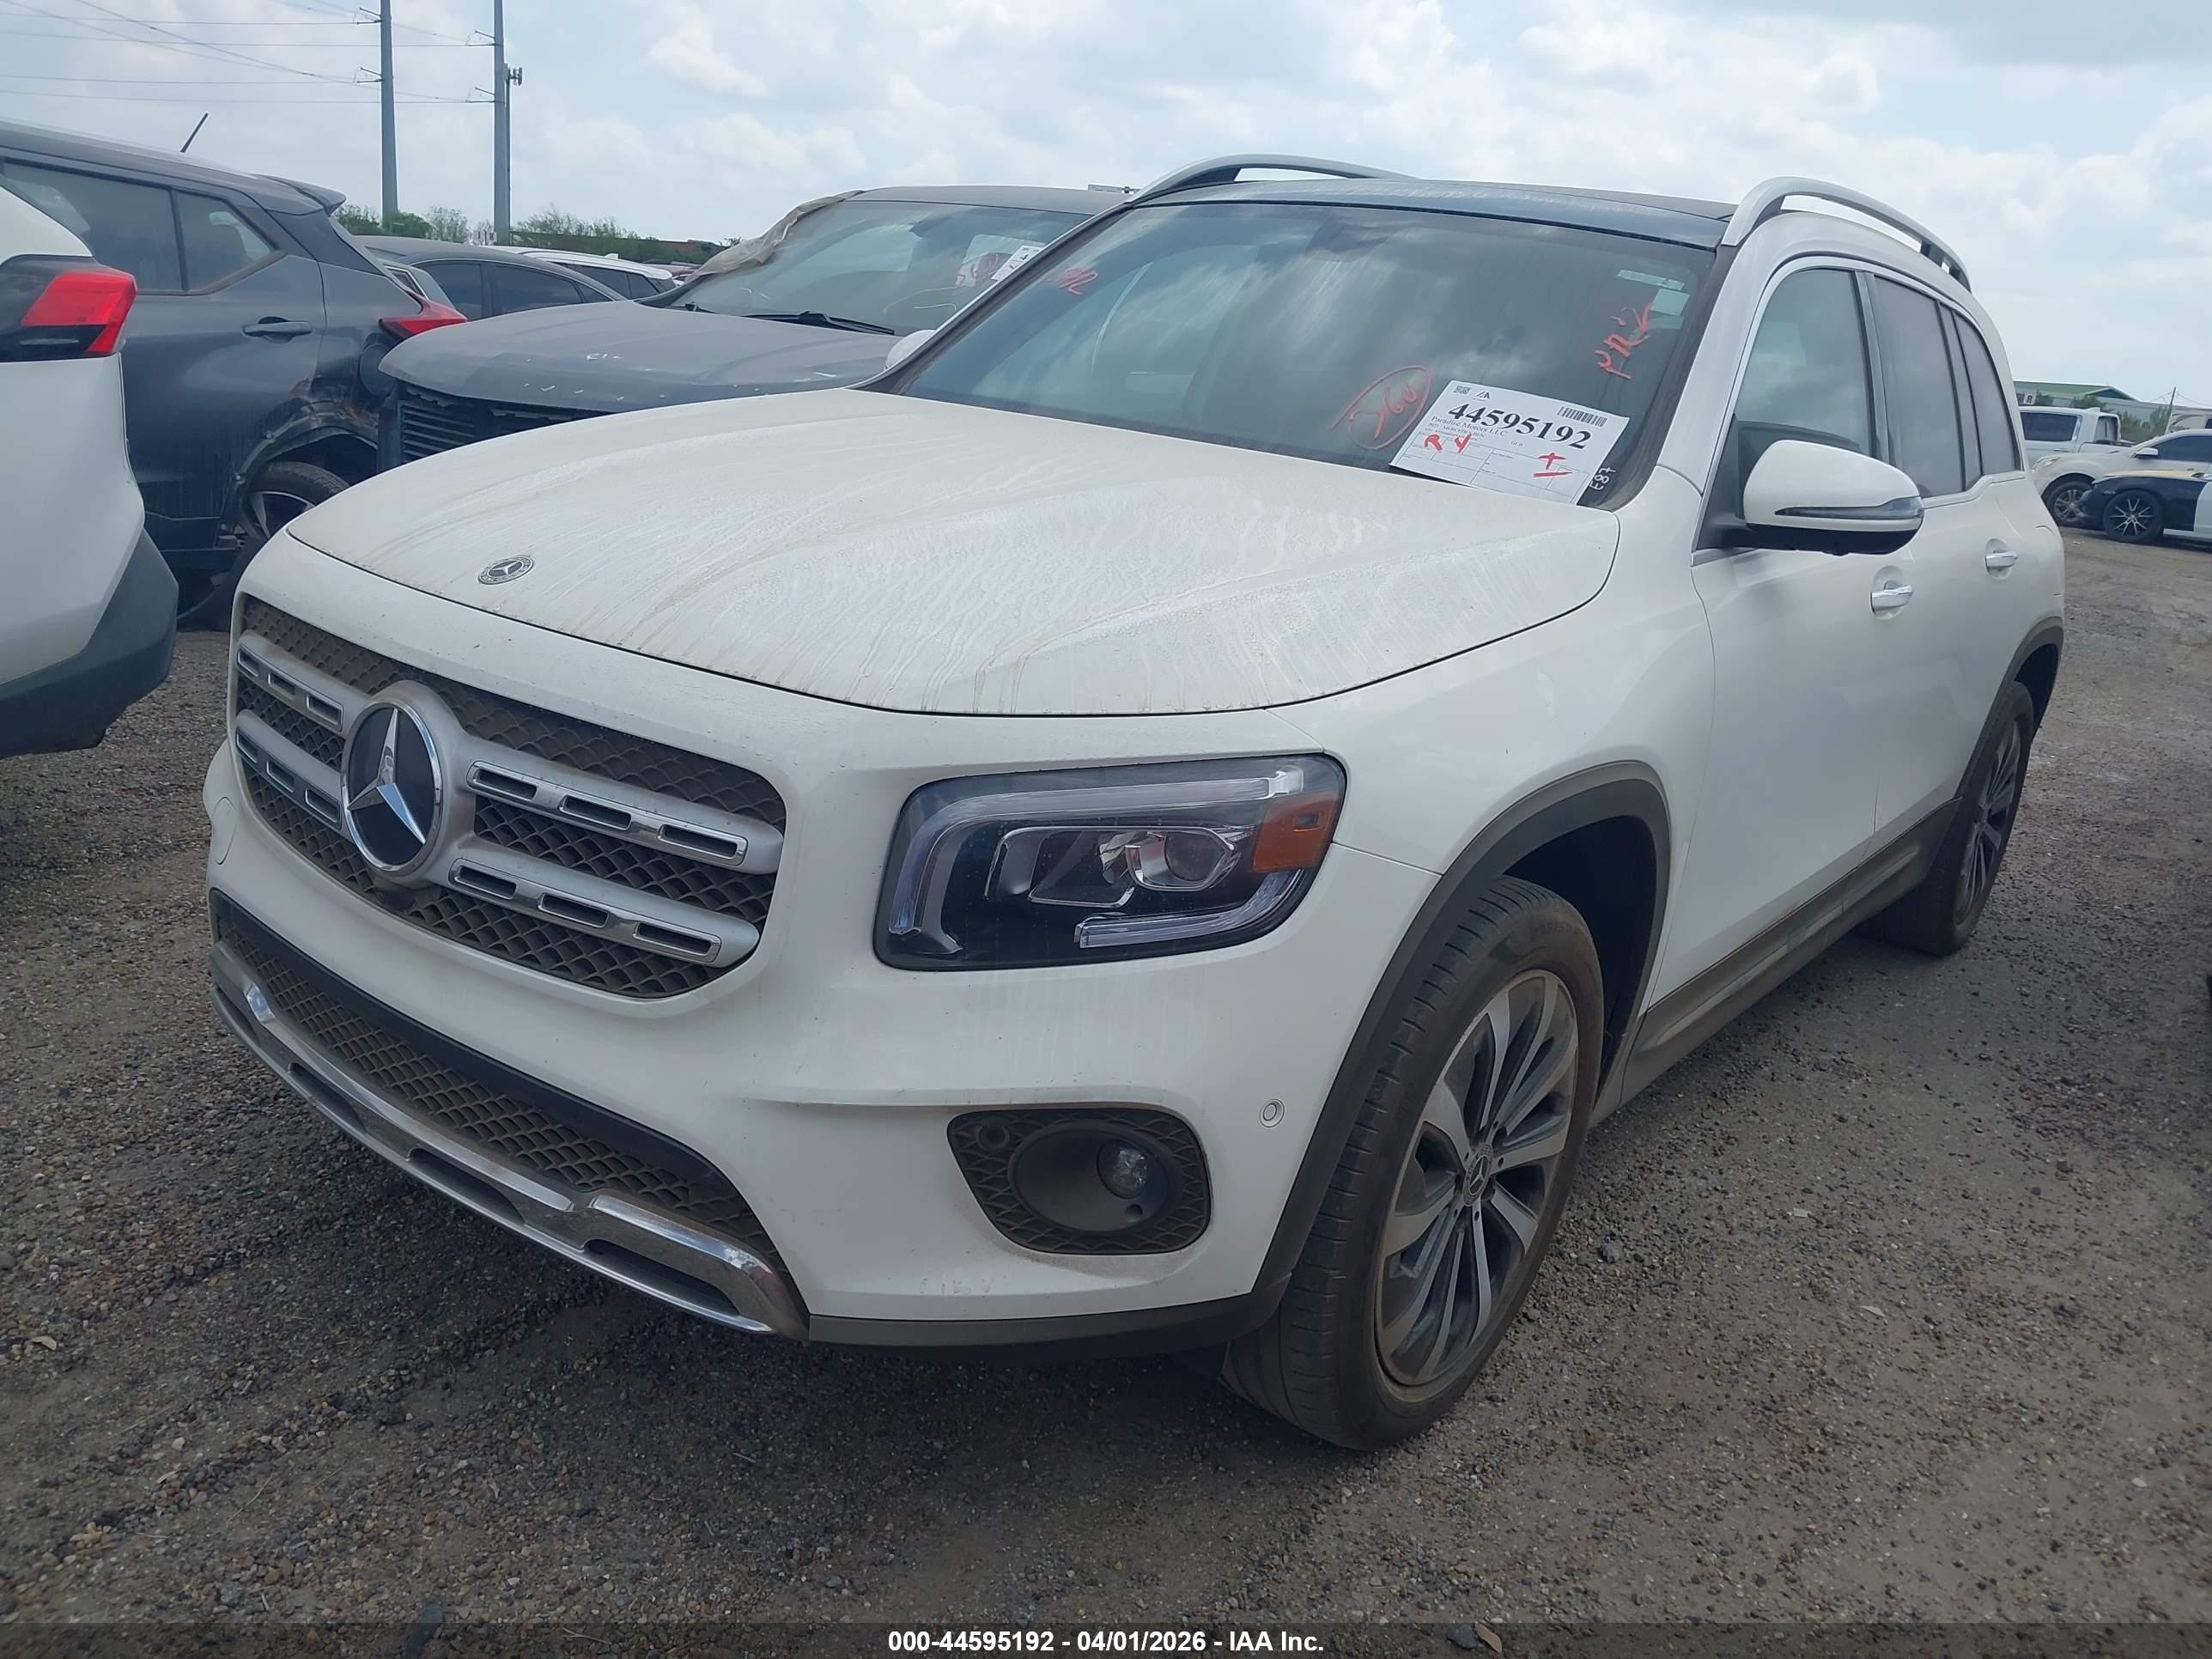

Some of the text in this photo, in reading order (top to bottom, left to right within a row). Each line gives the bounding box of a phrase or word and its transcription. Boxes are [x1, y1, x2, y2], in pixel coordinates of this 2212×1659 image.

[1431, 416, 1461, 428] Paradise
[1462, 422, 1489, 433] Motors
[1489, 428, 1510, 437] LLC
[1449, 403, 1591, 450] 44595192
